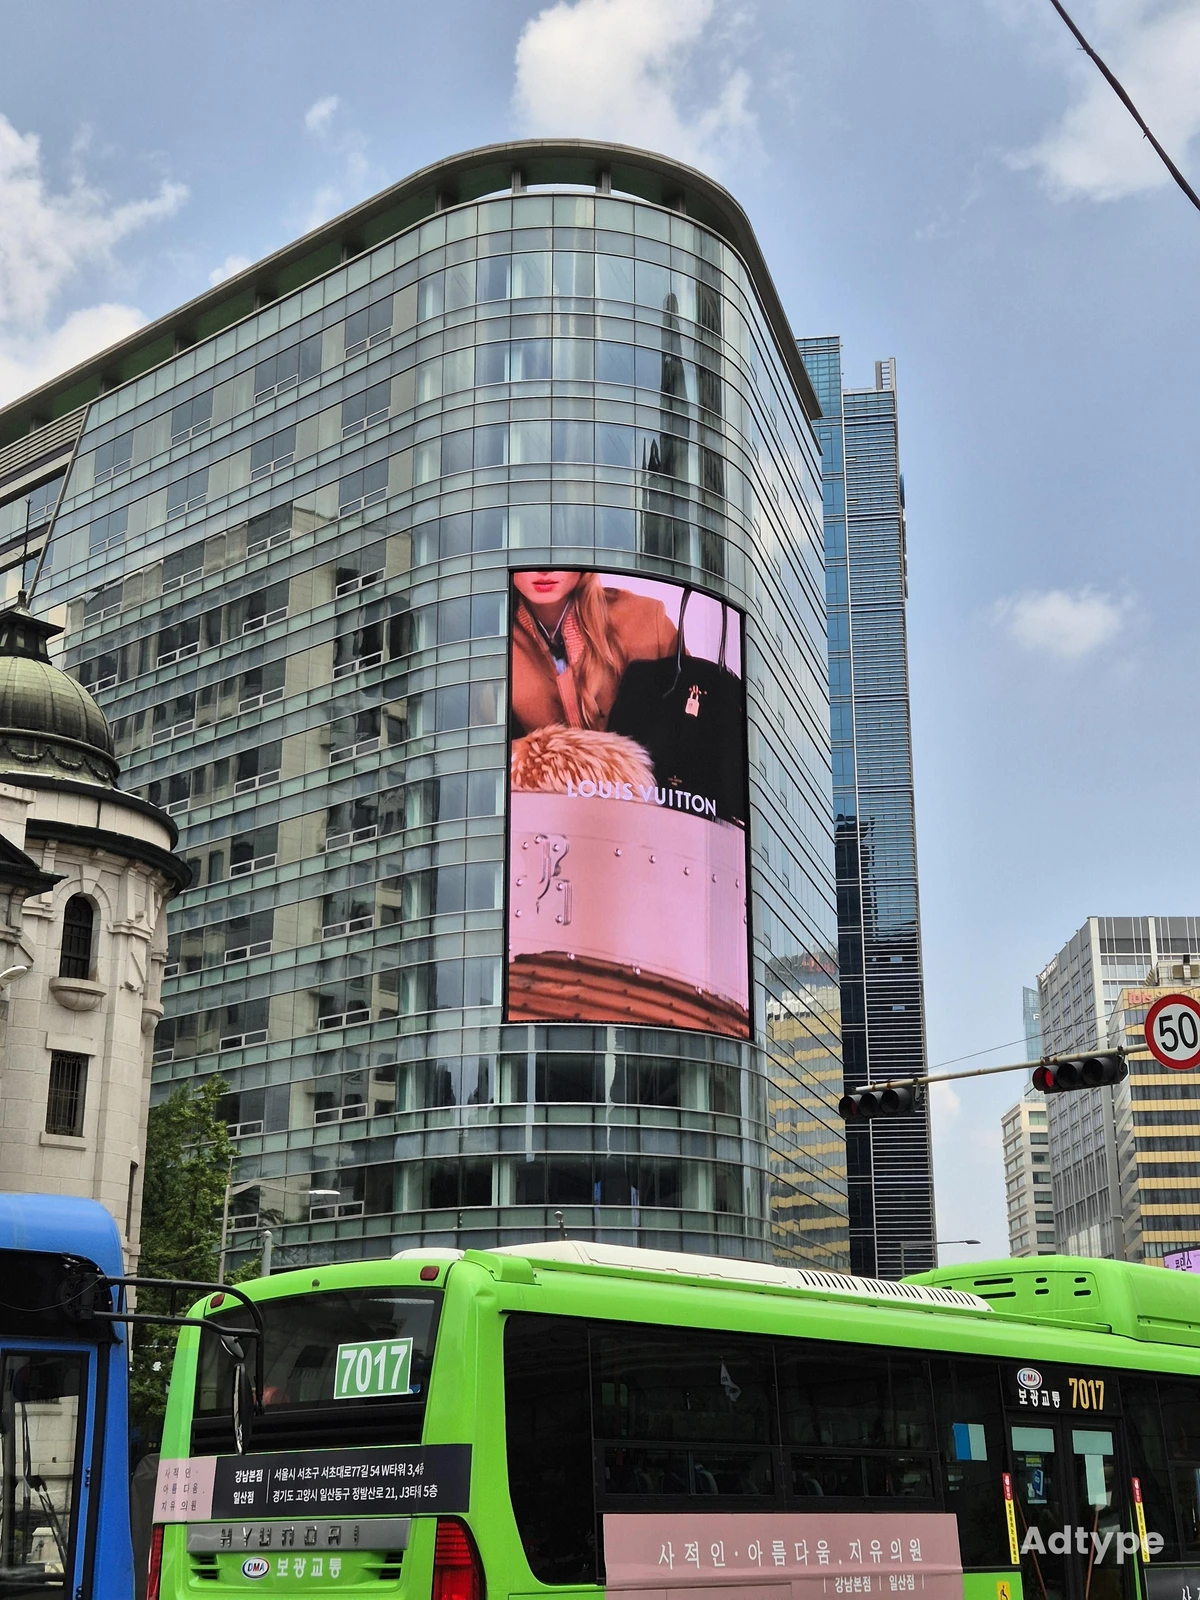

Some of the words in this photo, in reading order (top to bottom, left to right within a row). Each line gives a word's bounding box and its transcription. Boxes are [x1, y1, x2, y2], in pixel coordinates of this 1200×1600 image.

[567, 779, 633, 800] LOUIS
[639, 785, 717, 817] VUITTON
[1128, 991, 1152, 1004] ibis
[1158, 1011, 1199, 1052] 50
[342, 1344, 408, 1393] 7017
[1018, 1388, 1060, 1408] 보광교통
[1068, 1377, 1105, 1410] 7017
[234, 1469, 263, 1483] 강남본점
[274, 1468, 296, 1481] 서울시
[297, 1466, 320, 1480] 서초구
[321, 1464, 369, 1479] 서초대로77길
[370, 1464, 381, 1477] 54
[381, 1463, 406, 1477] W타워
[233, 1491, 254, 1504] 일산점
[272, 1490, 294, 1503] 경기도
[295, 1488, 318, 1502] 고양시
[319, 1487, 350, 1501] 일산동구
[352, 1486, 384, 1500] 정발산로
[423, 1484, 438, 1498] 5층
[161, 1500, 197, 1511] 지유의원
[220, 1525, 360, 1547] HYUNDAI
[849, 1537, 923, 1564] 지유의원
[247, 1562, 265, 1572] DMA
[276, 1557, 342, 1578] 보광교통
[835, 1576, 872, 1593] 강남본점
[889, 1574, 915, 1592] 일산점
